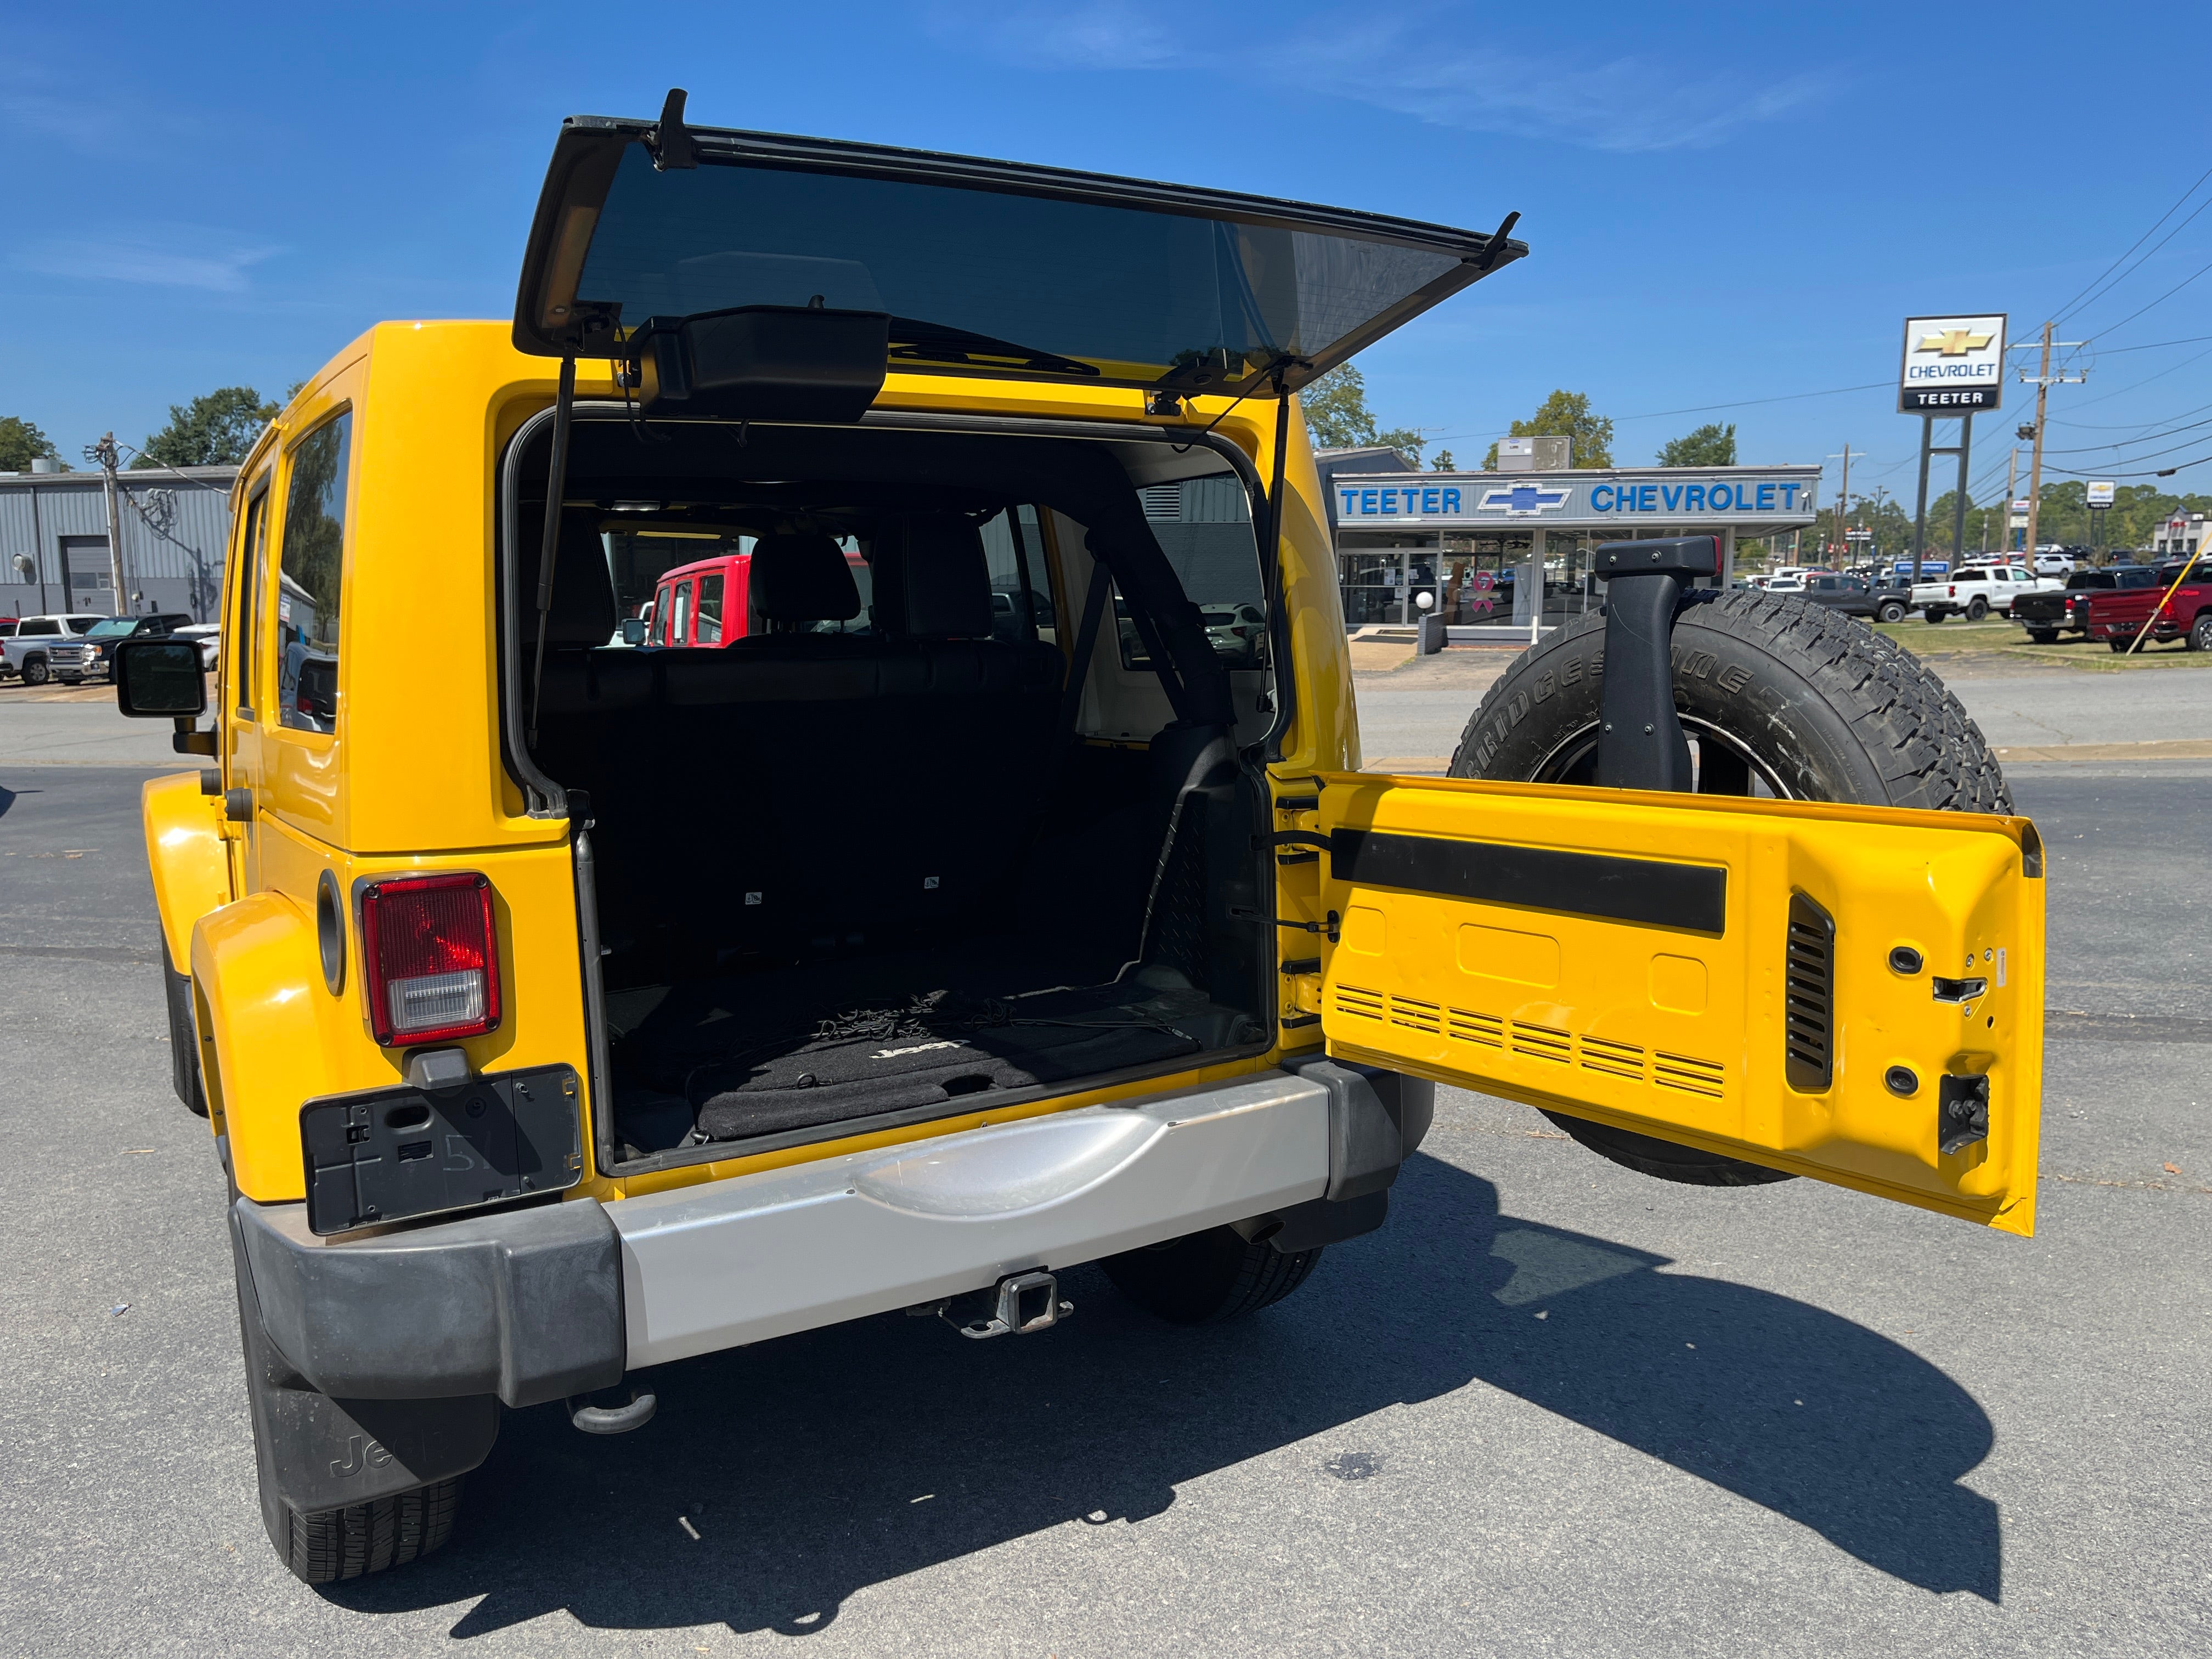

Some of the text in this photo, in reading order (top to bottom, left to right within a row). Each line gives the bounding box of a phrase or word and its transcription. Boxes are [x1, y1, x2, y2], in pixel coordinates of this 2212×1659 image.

[1910, 364, 1995, 378] CHEVROLET
[1917, 392, 1983, 405] TEETER
[1340, 483, 1801, 514] TEETER CHEVROLET
[869, 1040, 972, 1058] Jeep
